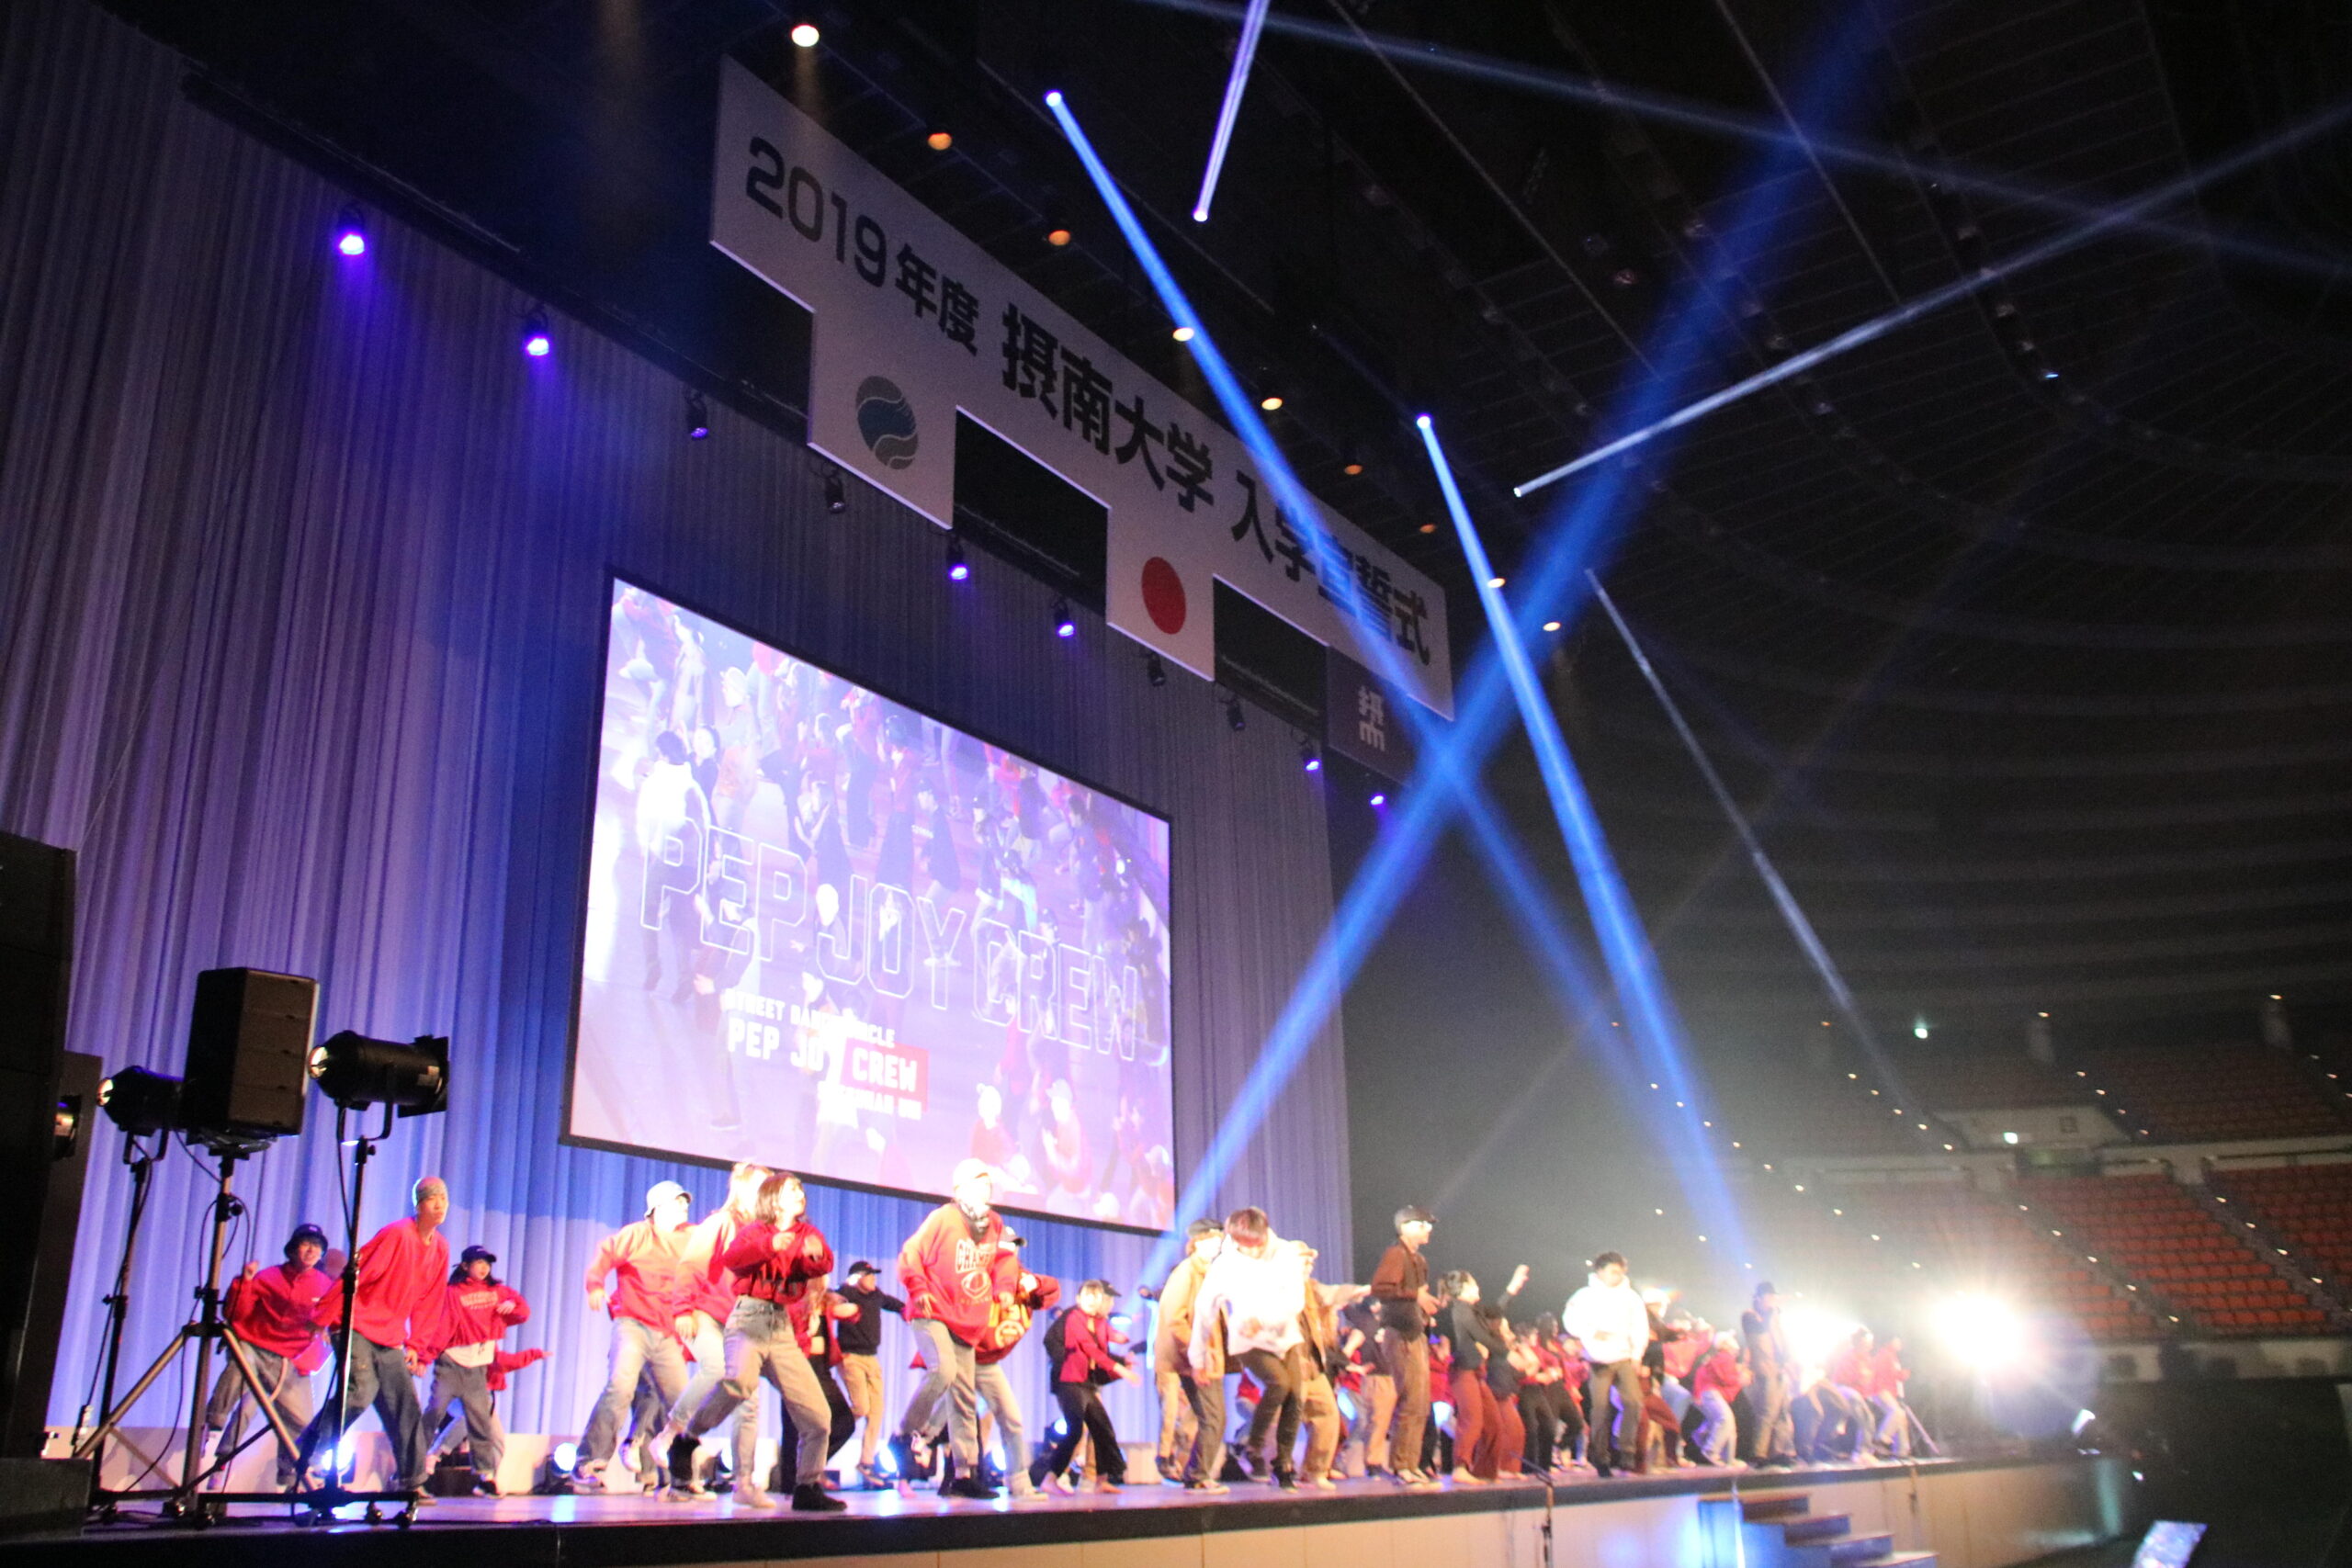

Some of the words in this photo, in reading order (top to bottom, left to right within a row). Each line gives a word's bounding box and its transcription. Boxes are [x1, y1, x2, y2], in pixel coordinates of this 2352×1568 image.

[745, 135, 979, 356] 2019年度
[1001, 301, 1215, 513] 摂南大学
[640, 810, 808, 962] PEP
[816, 874, 967, 1010] JOY
[974, 917, 1137, 1061] CREW
[728, 1016, 780, 1060] PEP
[790, 1031, 840, 1074] JO
[852, 1046, 918, 1092] CREW
